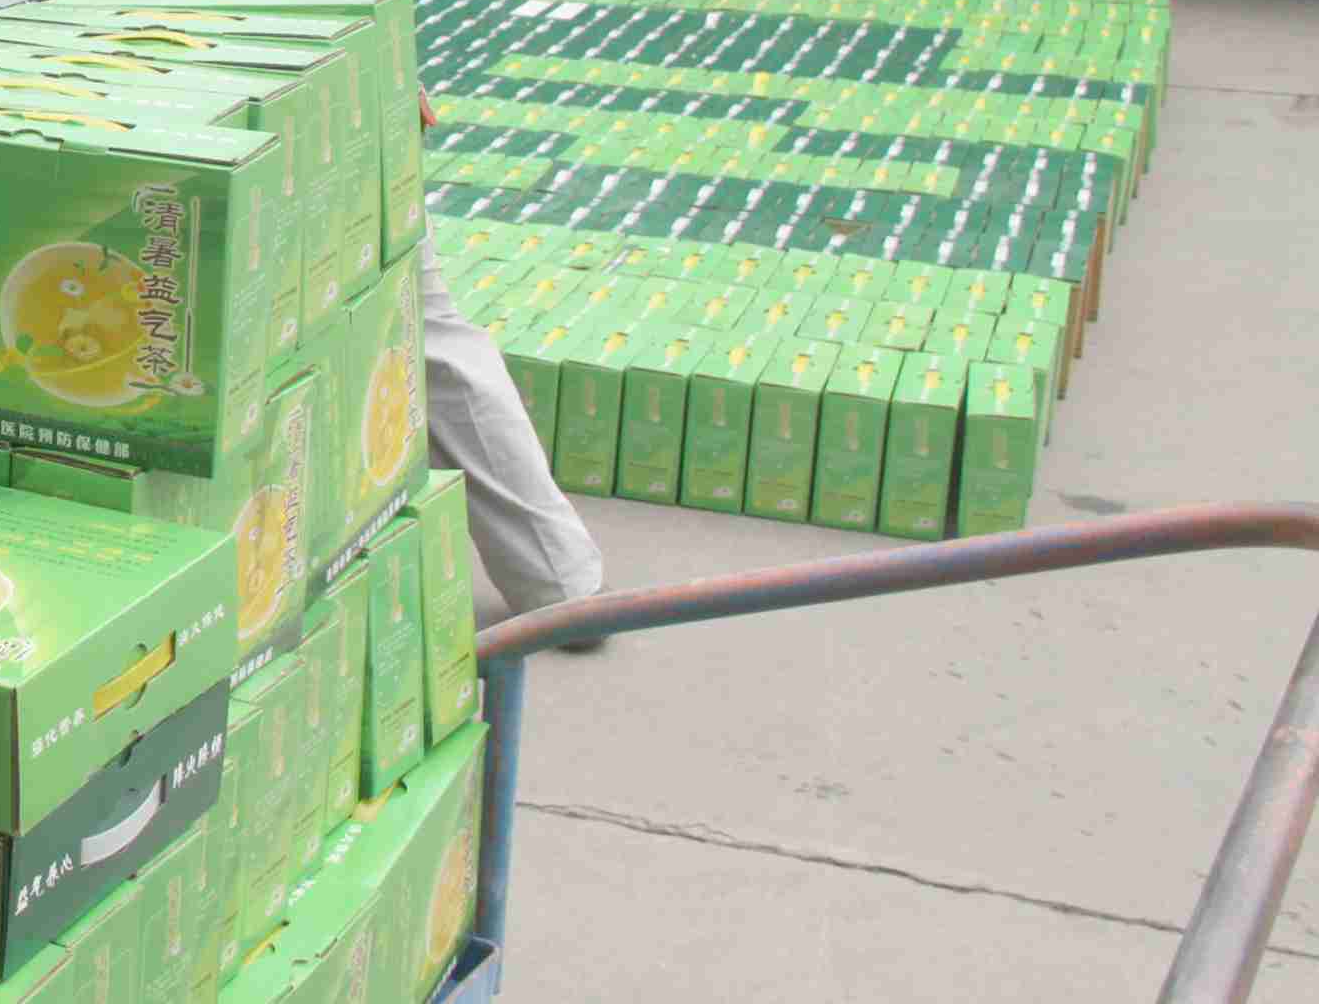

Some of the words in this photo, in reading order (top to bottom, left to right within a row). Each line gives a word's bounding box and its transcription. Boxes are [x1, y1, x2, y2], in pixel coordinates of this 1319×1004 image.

[136, 199, 185, 376] 清暑益气茶
